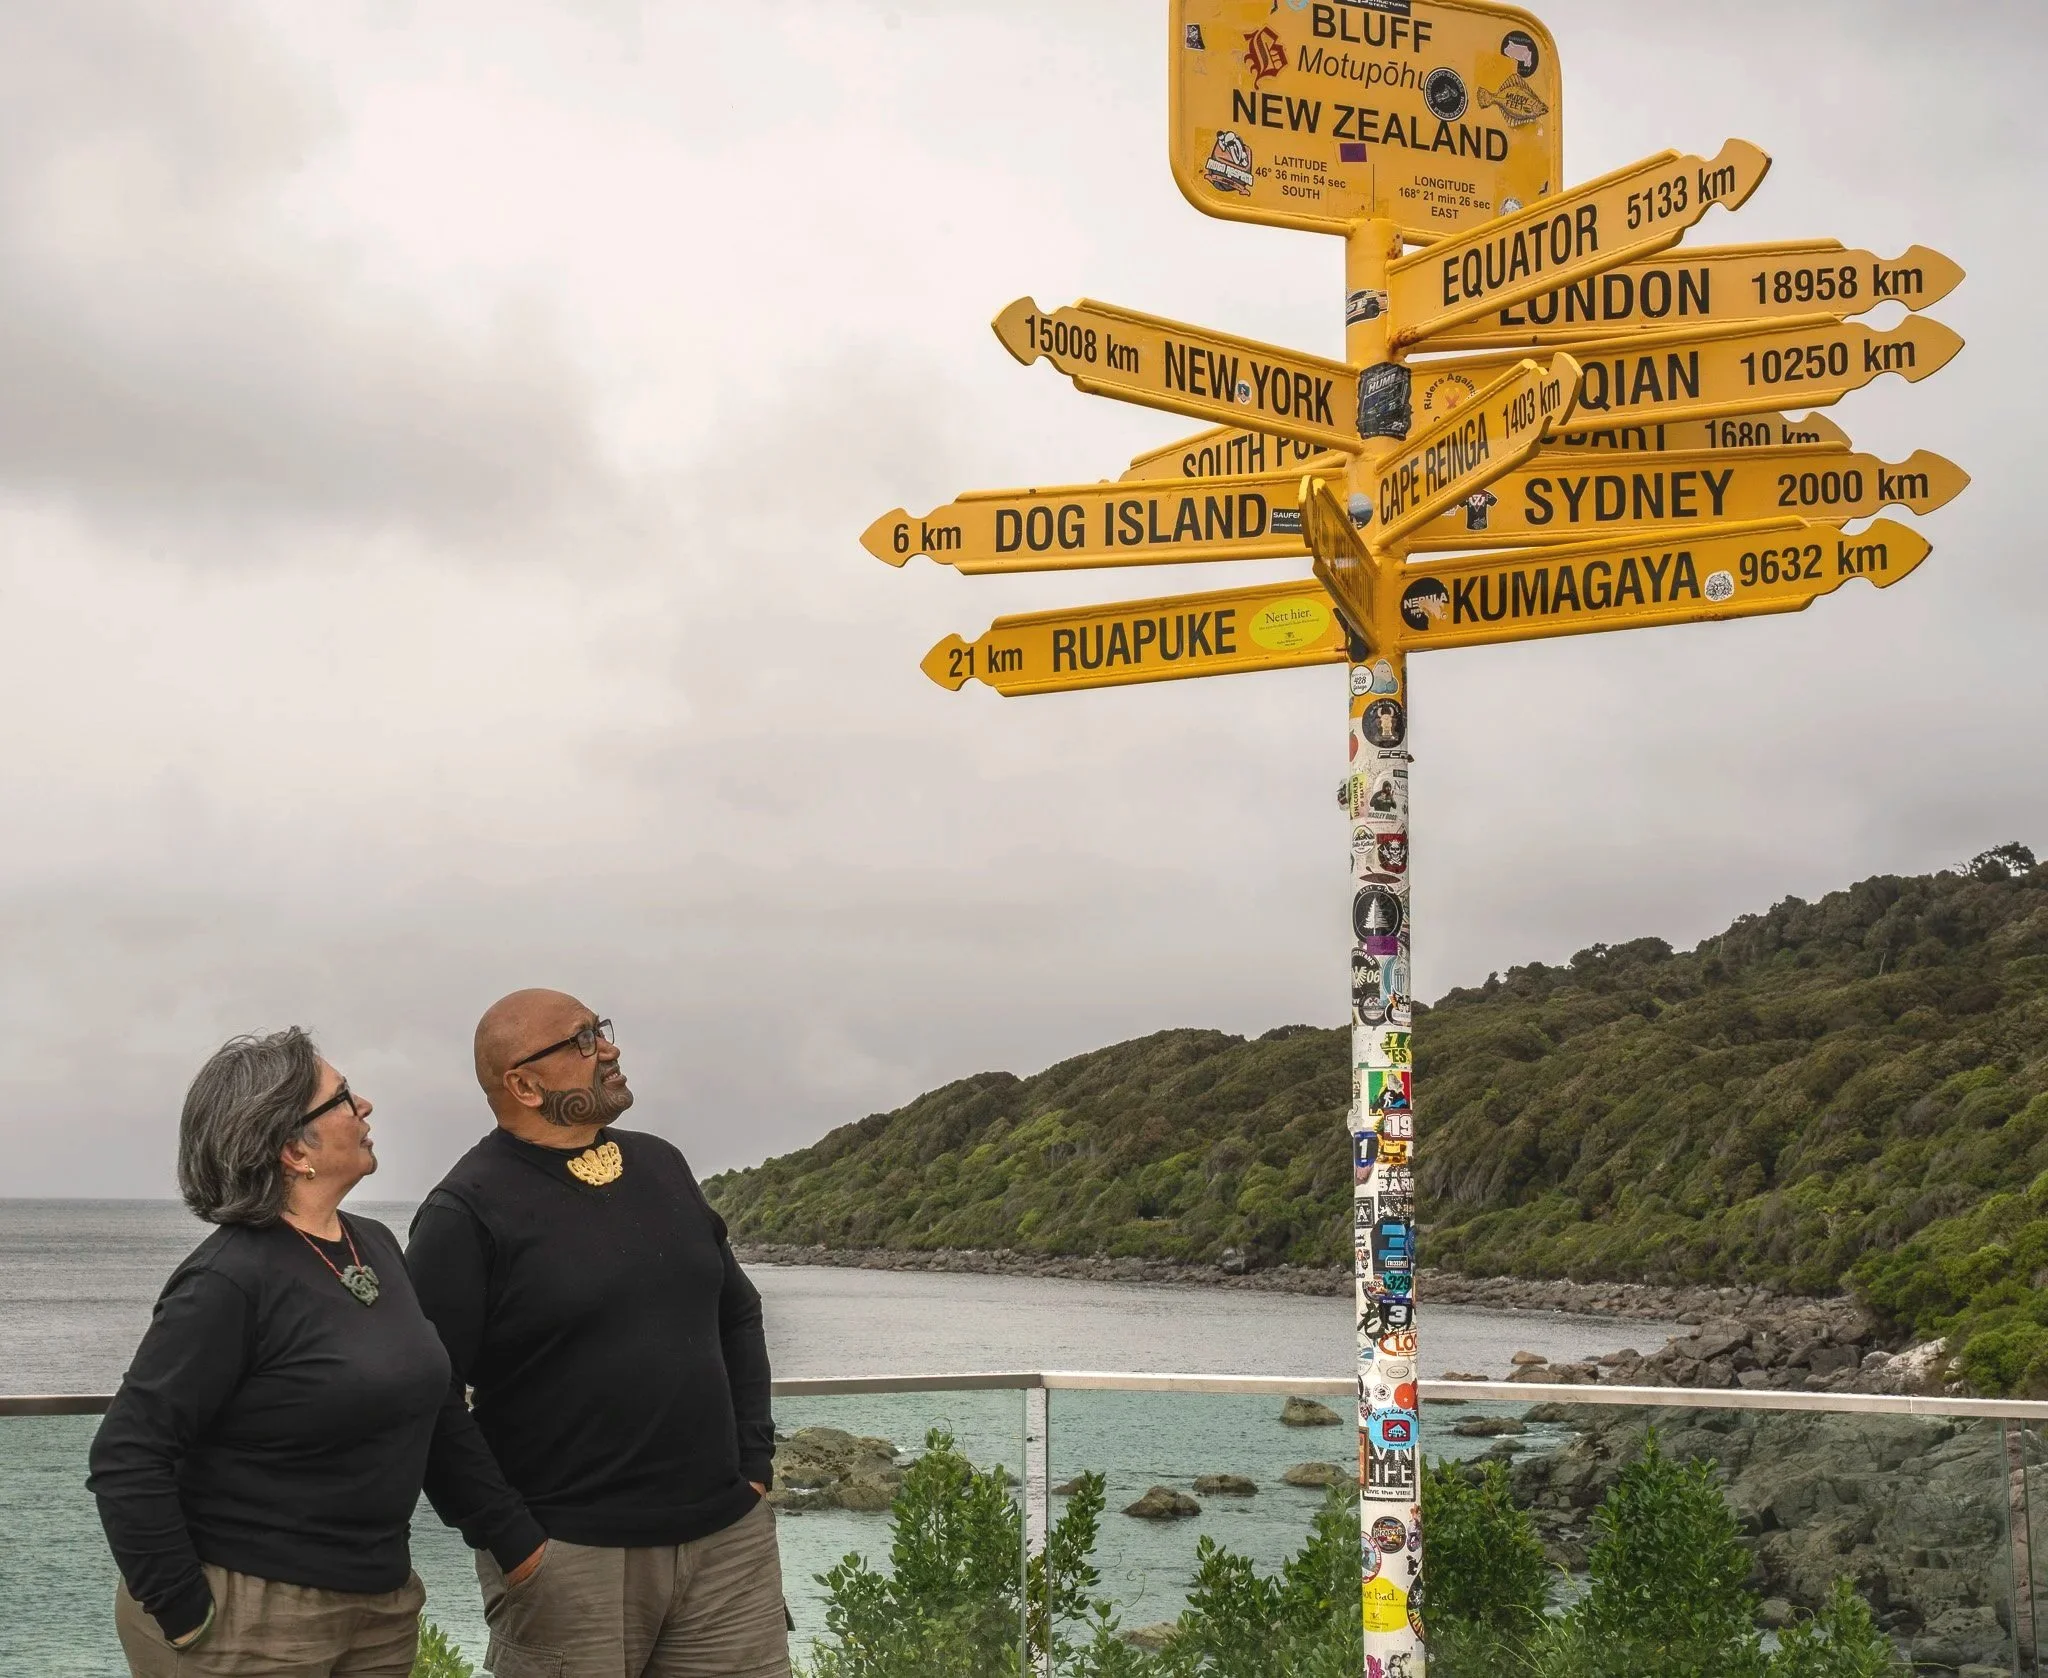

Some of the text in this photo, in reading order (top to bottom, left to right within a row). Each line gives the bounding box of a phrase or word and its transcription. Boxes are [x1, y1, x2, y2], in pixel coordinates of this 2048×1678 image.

[1312, 3, 1433, 53] BLUFF
[1232, 88, 1508, 162] NEW ZEALAND
[1255, 167, 1346, 189] 46° 36 min 54 sec
[1274, 155, 1327, 172] LATITUDE
[1414, 175, 1476, 194] LONGITUDE
[1282, 185, 1320, 200] SOUTH
[1398, 187, 1491, 210] 168° 21 min 26 sec
[1431, 206, 1459, 219] EAST
[1443, 161, 1736, 307] EQUATOR 5133 km
[1752, 266, 1858, 305] 18958
[1872, 262, 1924, 297] km
[1024, 314, 1335, 427] 15008 km NEW YORK
[1740, 346, 1849, 386] 10250
[1864, 338, 1916, 372] km
[1423, 376, 1445, 411] Riders
[1379, 378, 1561, 526] CAPE REINGA 1403 km
[1705, 419, 1771, 448] 1680
[1182, 433, 1265, 478] SOUTH
[1524, 466, 1930, 527] SYDNEY 2000 km
[893, 493, 1268, 554] 6 km DOG ISLAND
[1452, 540, 1888, 625] KUMAGAYA 9632 km
[1265, 612, 1288, 624] Nett
[1290, 609, 1312, 620] hier.
[948, 608, 1237, 678] 21 km RUAPUKE
[1386, 1114, 1413, 1138] 19
[1388, 1305, 1407, 1323] 3
